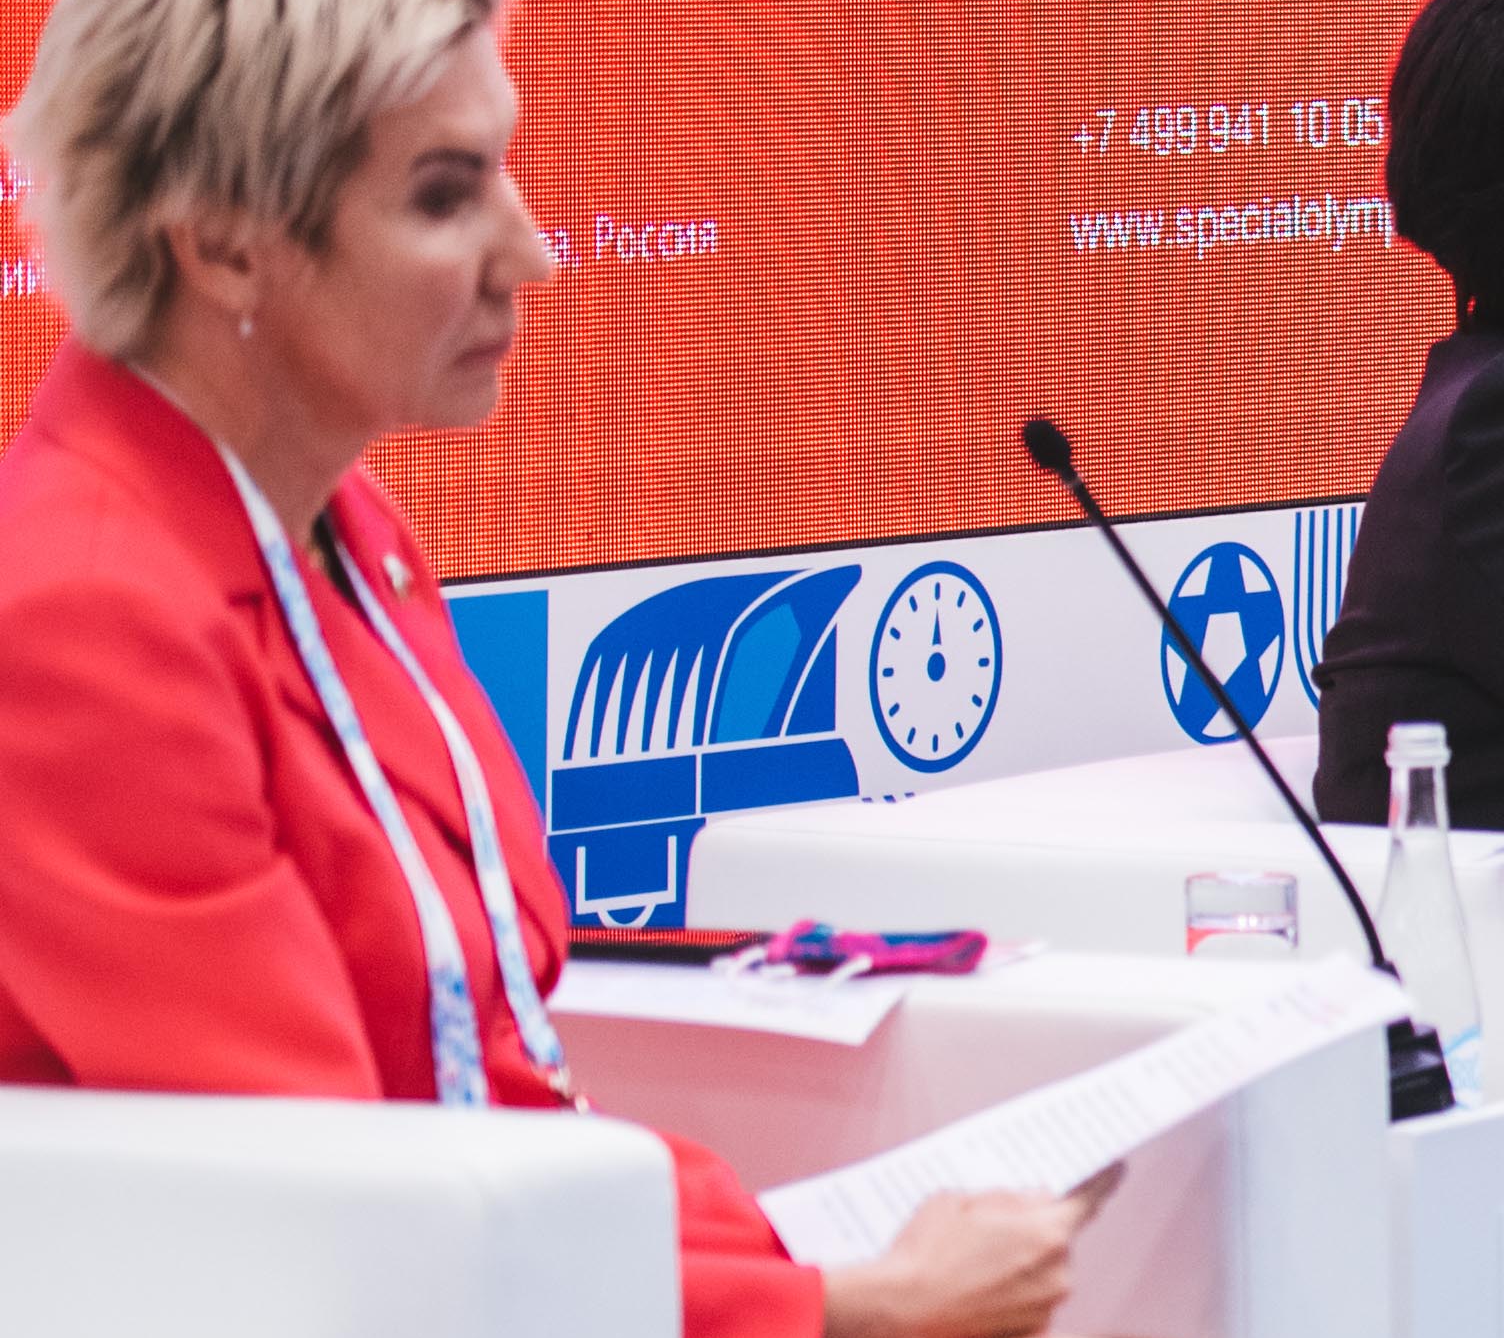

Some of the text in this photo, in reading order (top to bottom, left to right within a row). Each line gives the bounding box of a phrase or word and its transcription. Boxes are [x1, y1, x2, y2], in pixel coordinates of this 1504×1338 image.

[1071, 97, 1385, 156] +7 499 941 10 05
[595, 213, 718, 263] Россия
